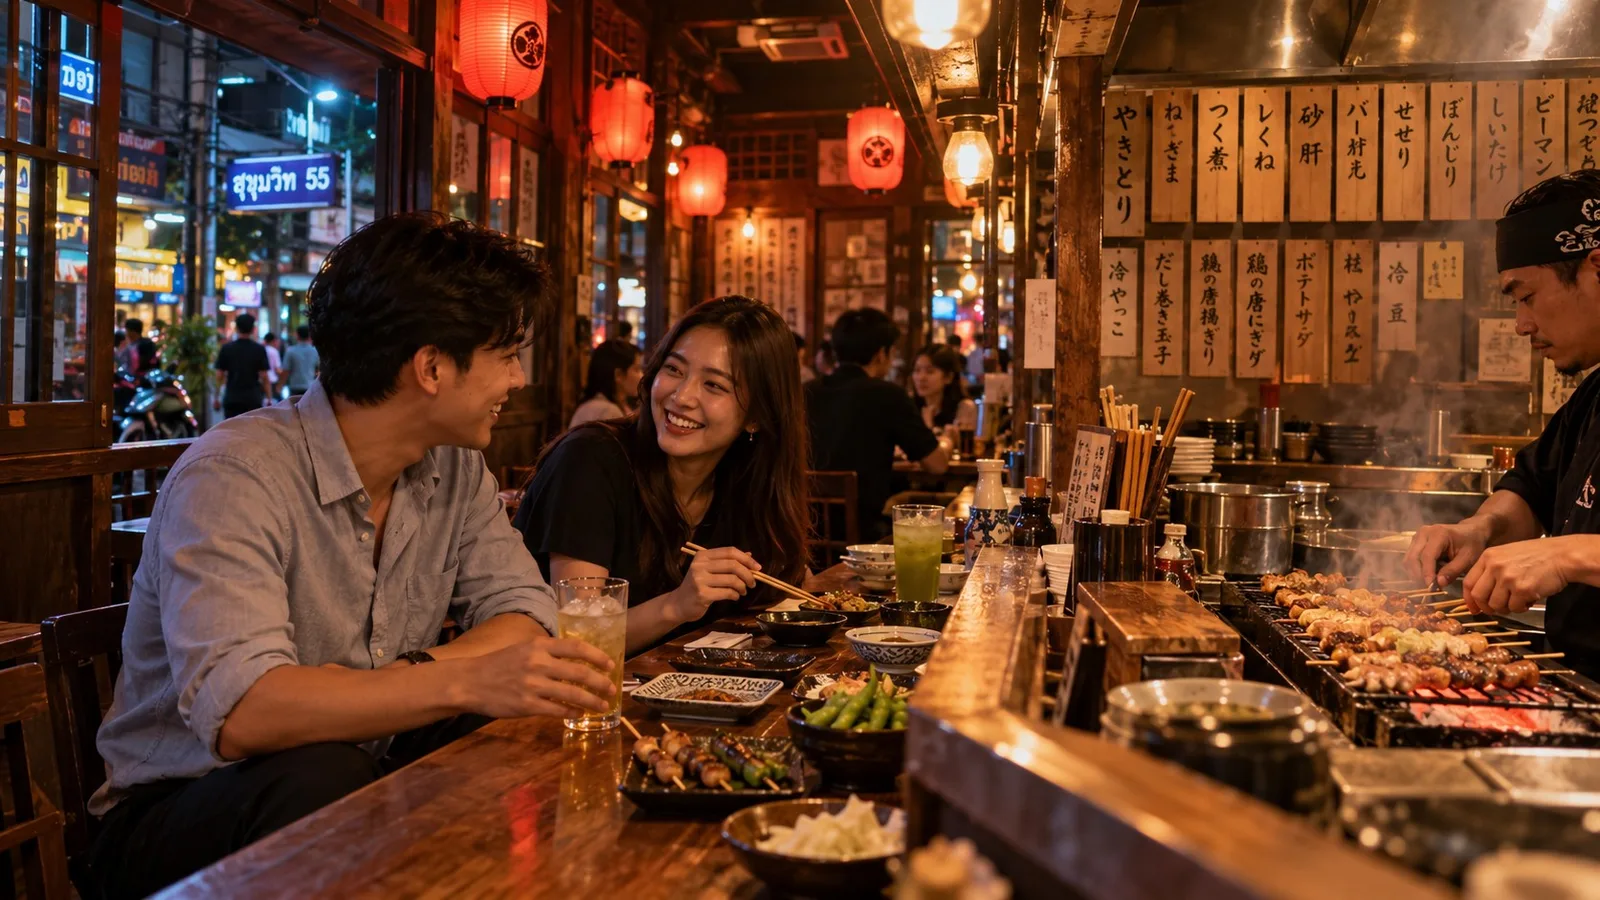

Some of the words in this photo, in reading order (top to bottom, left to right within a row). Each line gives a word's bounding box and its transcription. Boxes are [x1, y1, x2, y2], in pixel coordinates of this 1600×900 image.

[1112, 105, 1138, 224] やきとり
[1206, 104, 1229, 172] つく煮
[1298, 102, 1325, 166] 砂肝
[1394, 101, 1415, 169] せせり
[1441, 97, 1464, 188] ぼんじり
[1488, 97, 1508, 185] しいたけ
[305, 166, 330, 190] 55
[1154, 252, 1175, 365] だし巻き玉子
